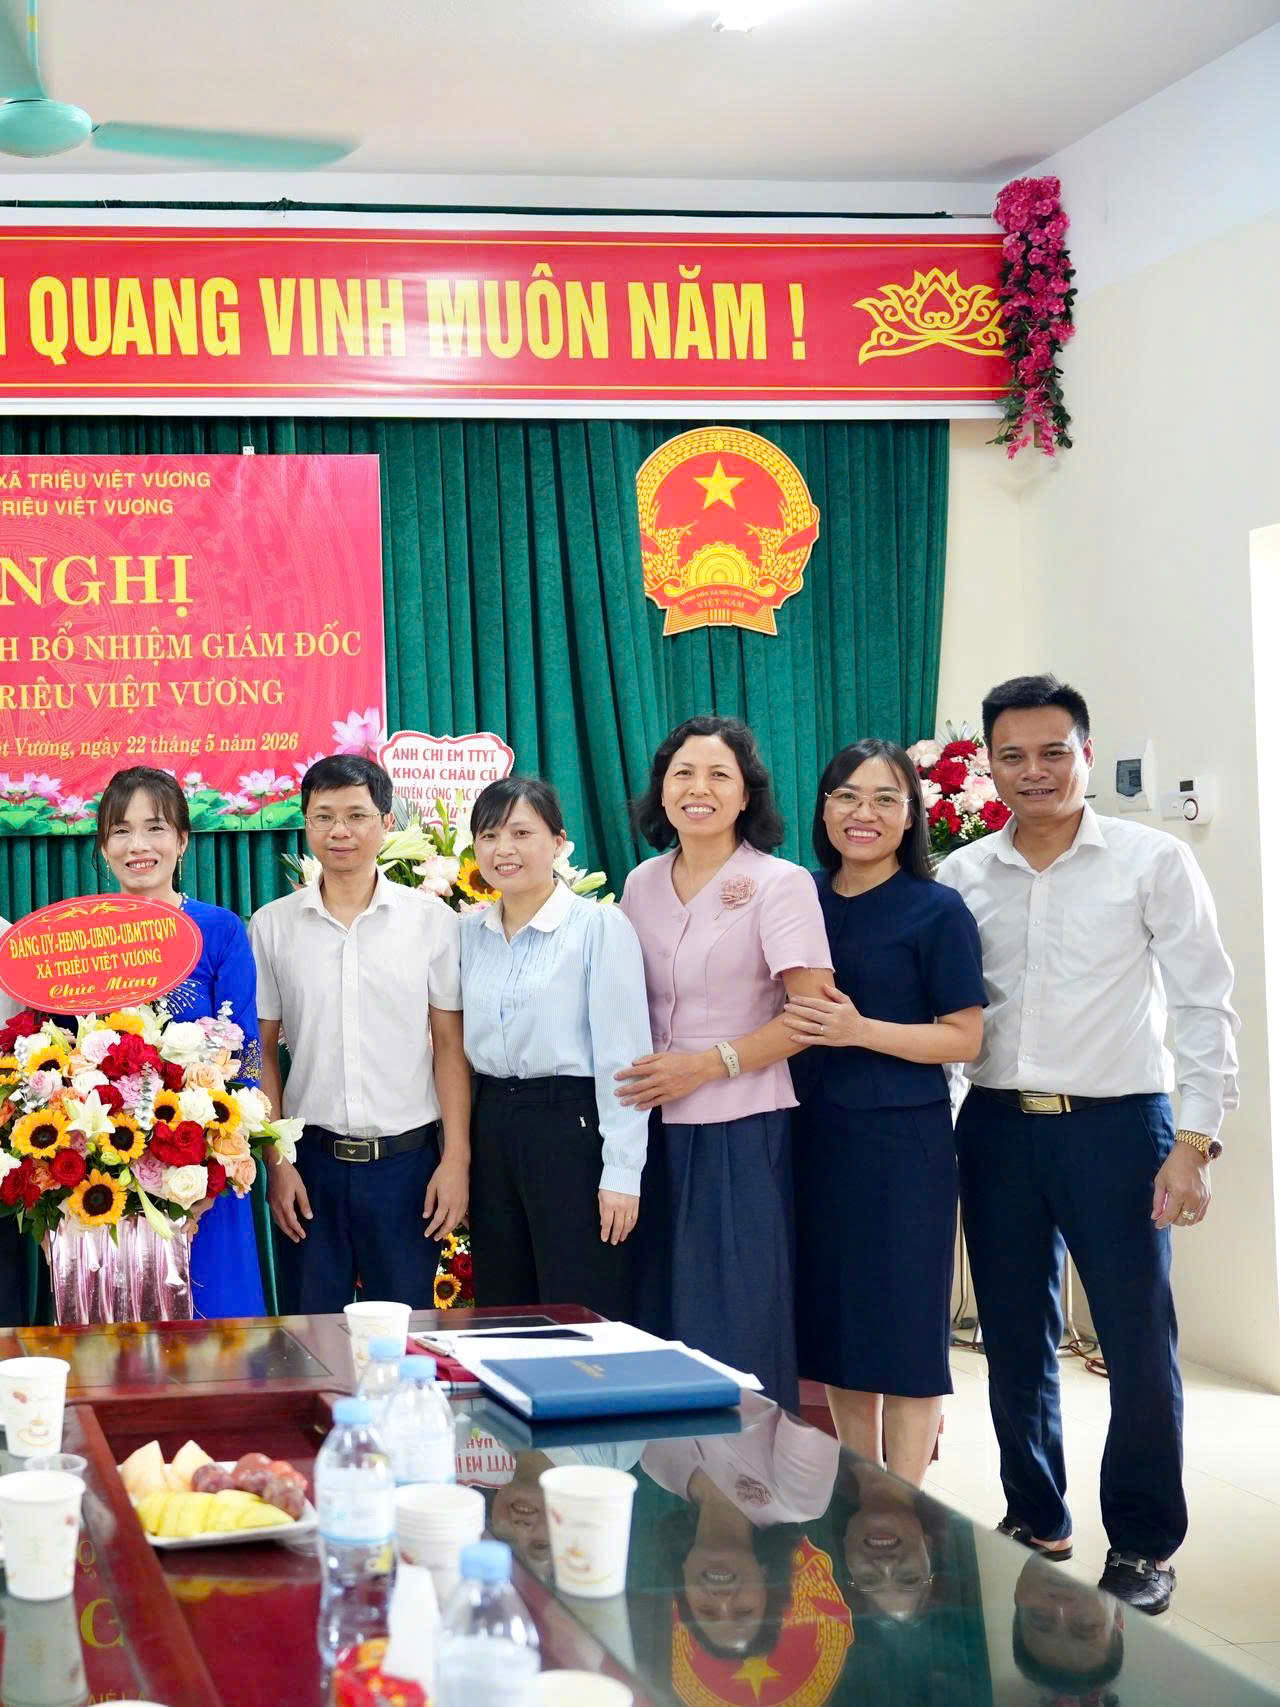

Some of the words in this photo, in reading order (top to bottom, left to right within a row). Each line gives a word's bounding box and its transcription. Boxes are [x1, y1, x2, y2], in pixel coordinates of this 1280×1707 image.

[28, 275, 241, 366] QUANG
[258, 277, 408, 358] VINH
[426, 262, 609, 360] MUÔN
[627, 264, 768, 361] NĂM
[789, 283, 806, 361] !
[28, 470, 86, 490] TRIỆU
[93, 469, 136, 491] VIỆT
[142, 470, 211, 488] VƯƠNG
[54, 496, 97, 519] VIỆT
[104, 497, 174, 515] VƯƠNG
[30, 621, 75, 662] BỔ
[84, 626, 193, 666] NHIỆM
[201, 625, 285, 659] GIÁM
[293, 620, 362, 657] ĐỐC
[84, 674, 161, 715] VIỆT
[168, 677, 286, 707] VƯƠNG
[15, 736, 75, 761] Vương,
[80, 735, 121, 758] ngày
[127, 734, 146, 754] 22
[150, 734, 200, 755] tháng
[205, 732, 215, 752] 5
[220, 733, 257, 752] năm
[261, 732, 299, 752] 2026
[392, 748, 418, 760] ANH
[423, 748, 443, 764] CHỊ
[448, 749, 464, 762] EM
[468, 749, 497, 762] TTYT
[440, 766, 475, 781] CHÂU
[9, 931, 40, 959] ĐẢNG
[36, 960, 53, 980] XÃ
[55, 956, 89, 979] TRIỆU
[91, 952, 119, 975] VIỆT
[120, 948, 162, 967] VƯƠNG
